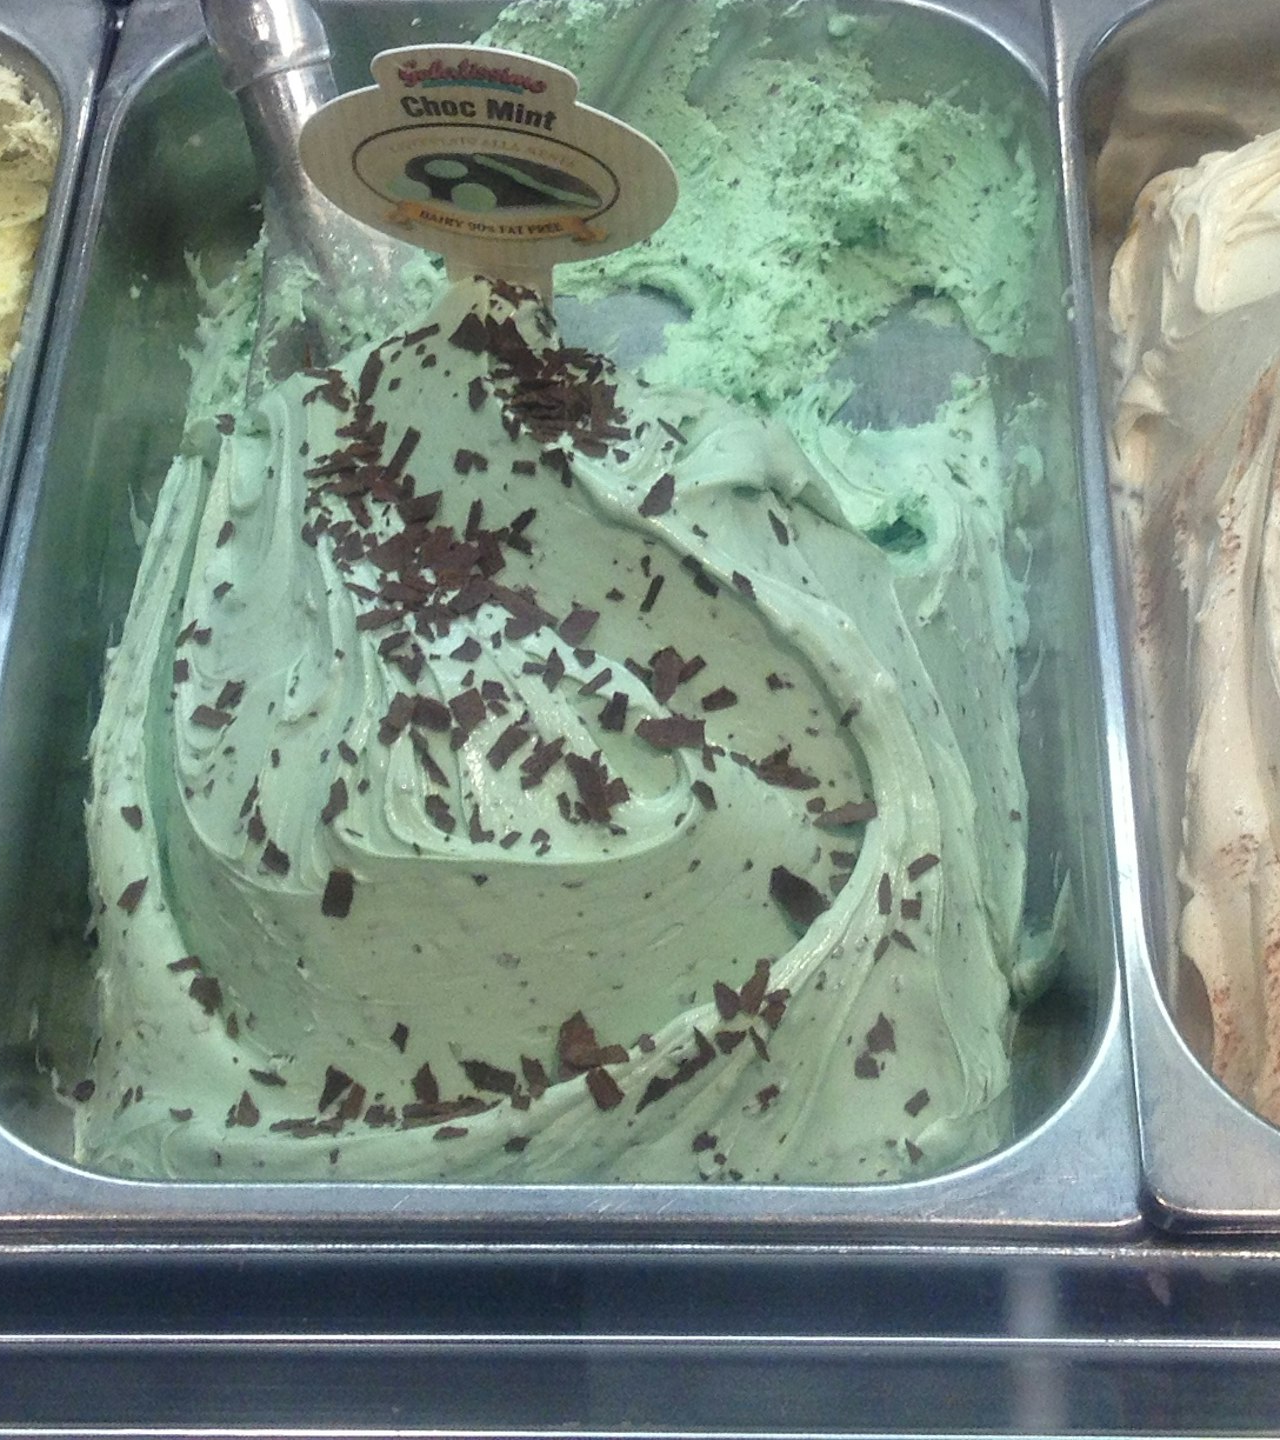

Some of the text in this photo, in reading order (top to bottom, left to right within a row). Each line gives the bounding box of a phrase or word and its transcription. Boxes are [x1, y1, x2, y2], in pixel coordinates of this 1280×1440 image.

[400, 95, 558, 131] Choc Mint
[418, 209, 465, 228] DAIRY
[499, 224, 524, 236] FAT
[527, 222, 565, 236] FREE
